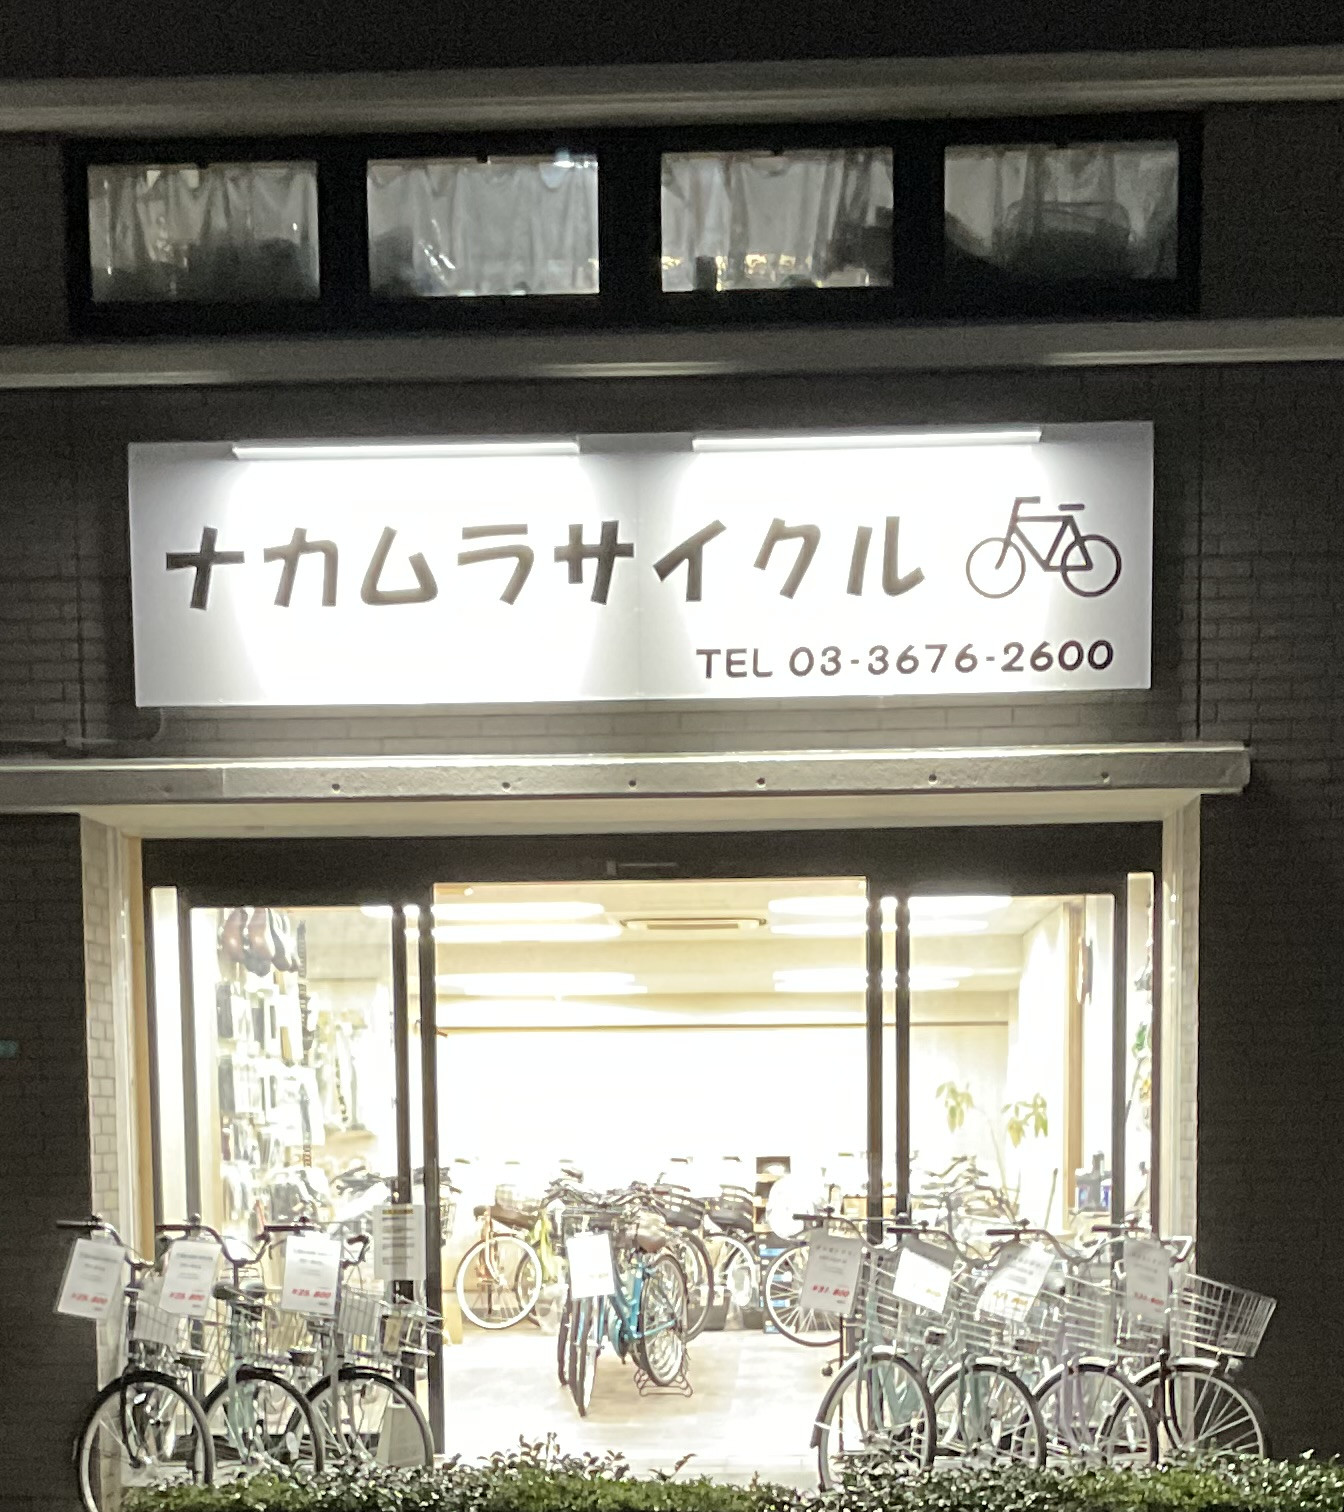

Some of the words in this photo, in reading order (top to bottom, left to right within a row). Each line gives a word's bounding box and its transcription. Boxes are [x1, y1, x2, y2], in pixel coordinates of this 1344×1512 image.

[164, 515, 926, 612] ナカムラサイクル
[695, 647, 775, 680] TEL
[788, 639, 1115, 678] 03-3676-2600
